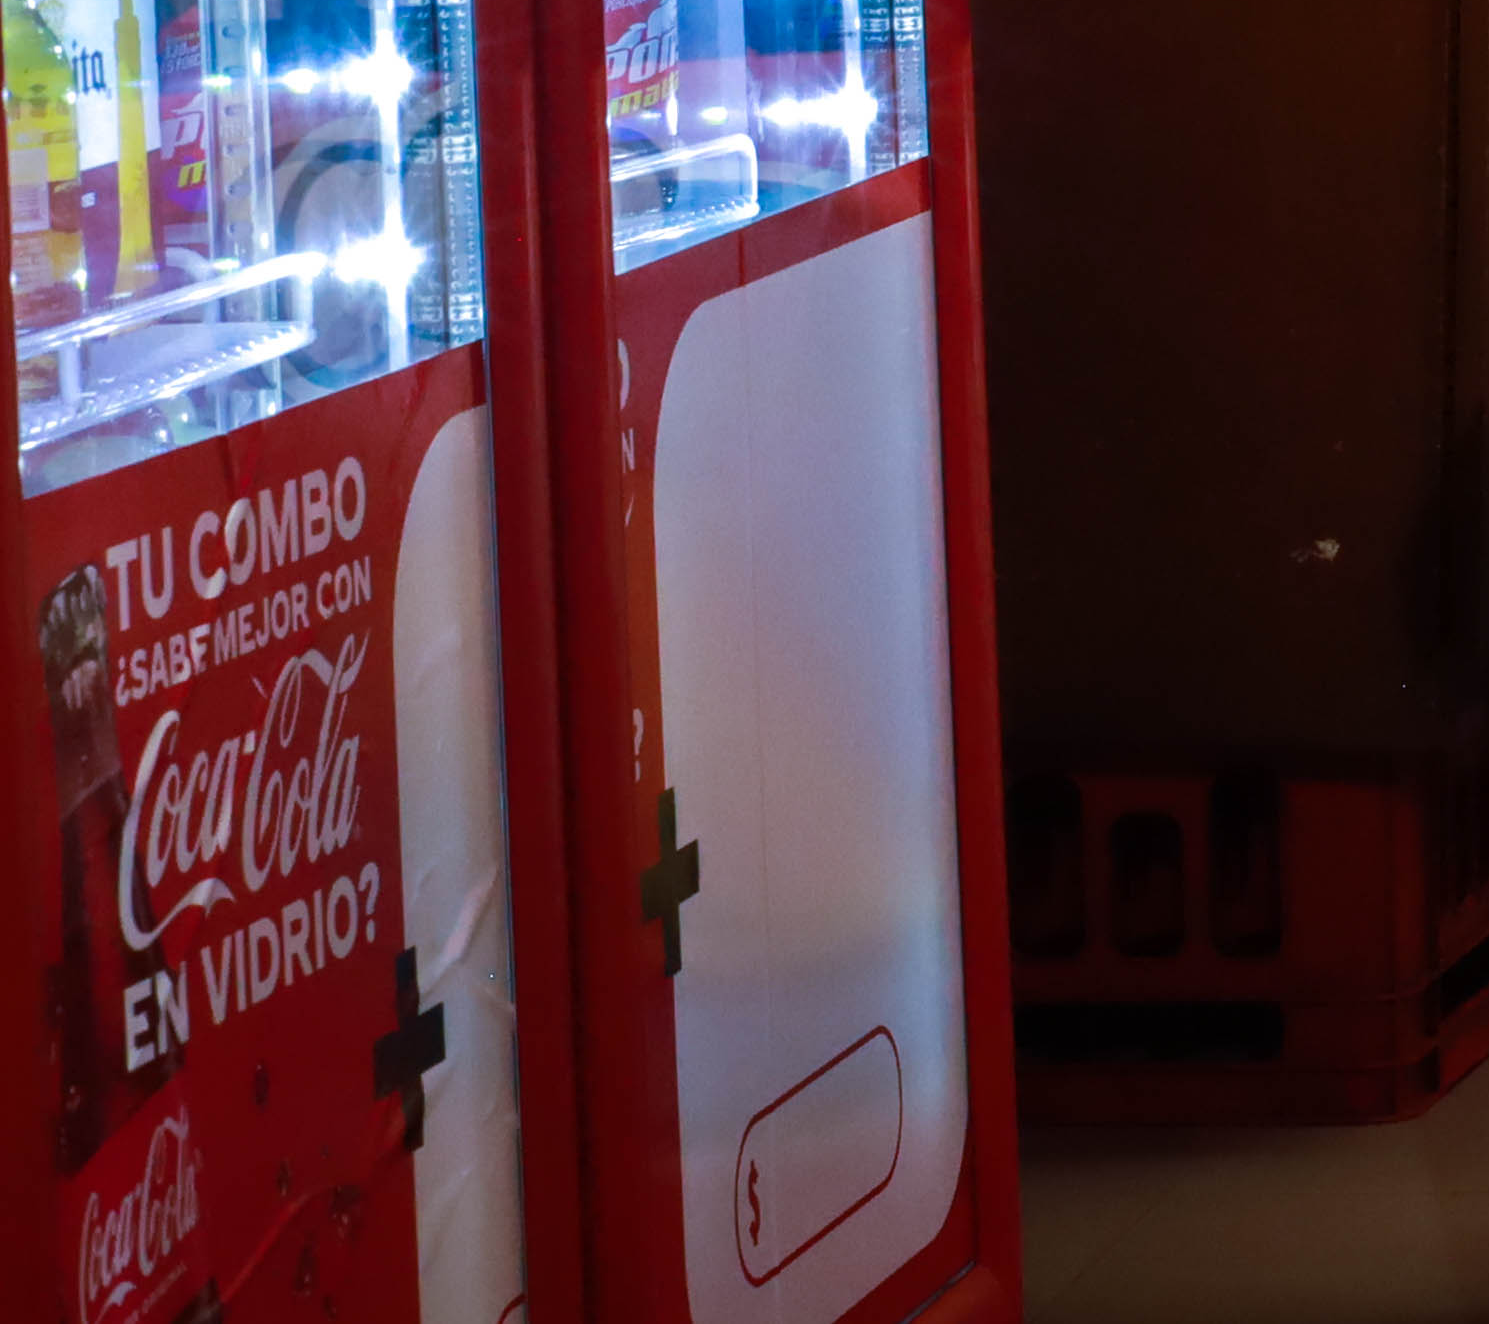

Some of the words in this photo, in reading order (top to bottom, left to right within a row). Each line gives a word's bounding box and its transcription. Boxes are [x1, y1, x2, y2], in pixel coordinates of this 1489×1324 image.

[107, 513, 174, 633] TU
[190, 456, 366, 600] COMBO
[115, 624, 211, 708] ¿SABE
[214, 581, 309, 664] MEJOR
[316, 557, 372, 616] CON
[117, 627, 371, 953] Coca-Cola
[123, 970, 188, 1074] EN
[200, 862, 381, 1026] VIDRIO?
